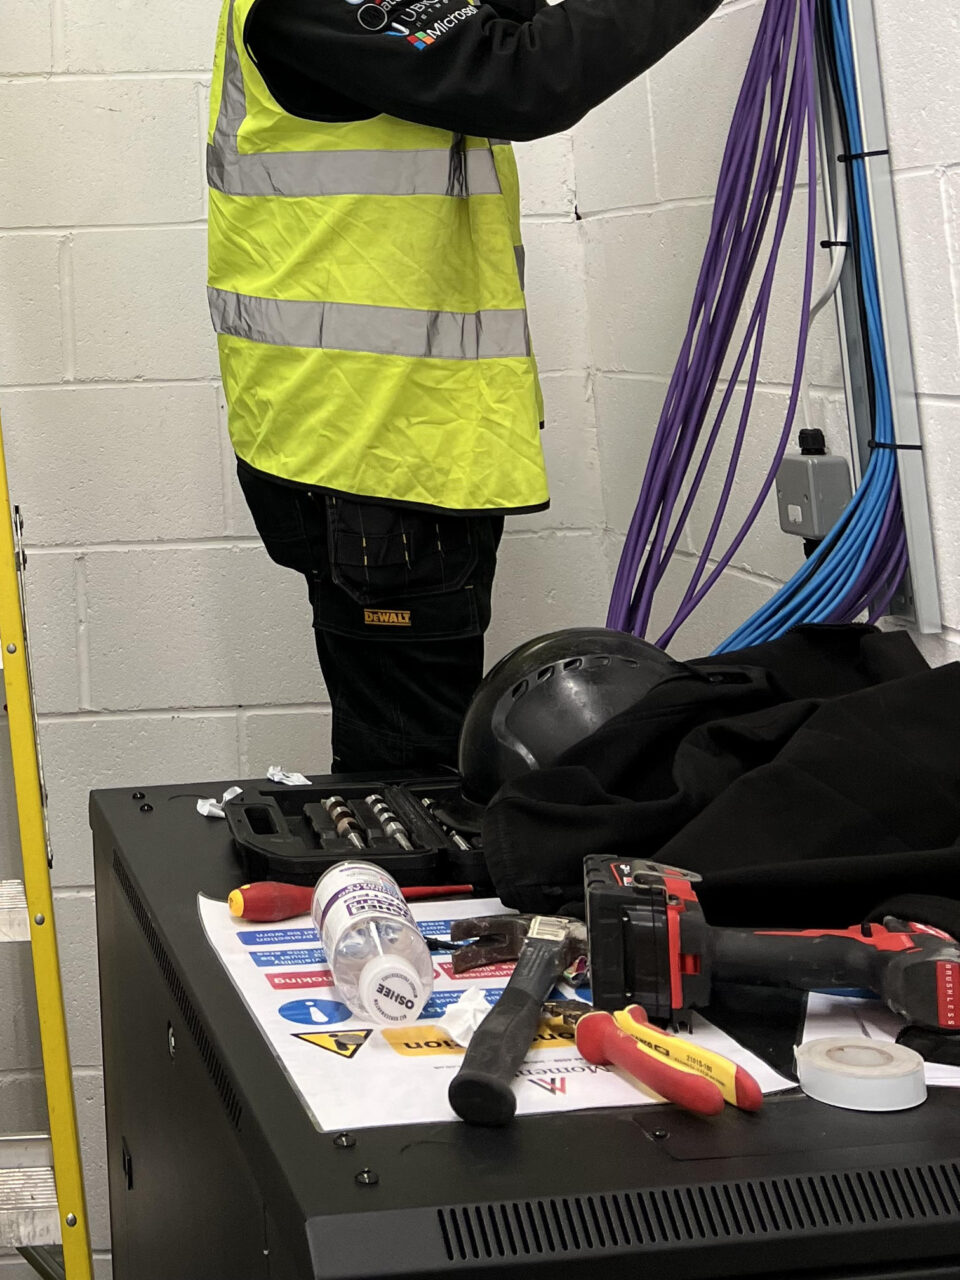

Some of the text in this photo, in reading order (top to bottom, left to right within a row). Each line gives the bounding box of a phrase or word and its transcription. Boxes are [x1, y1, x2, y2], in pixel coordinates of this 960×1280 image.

[375, 983, 415, 1010] OSHEE
[945, 963, 955, 1026] BRUSHLESS
[514, 1064, 611, 1078] Momen
